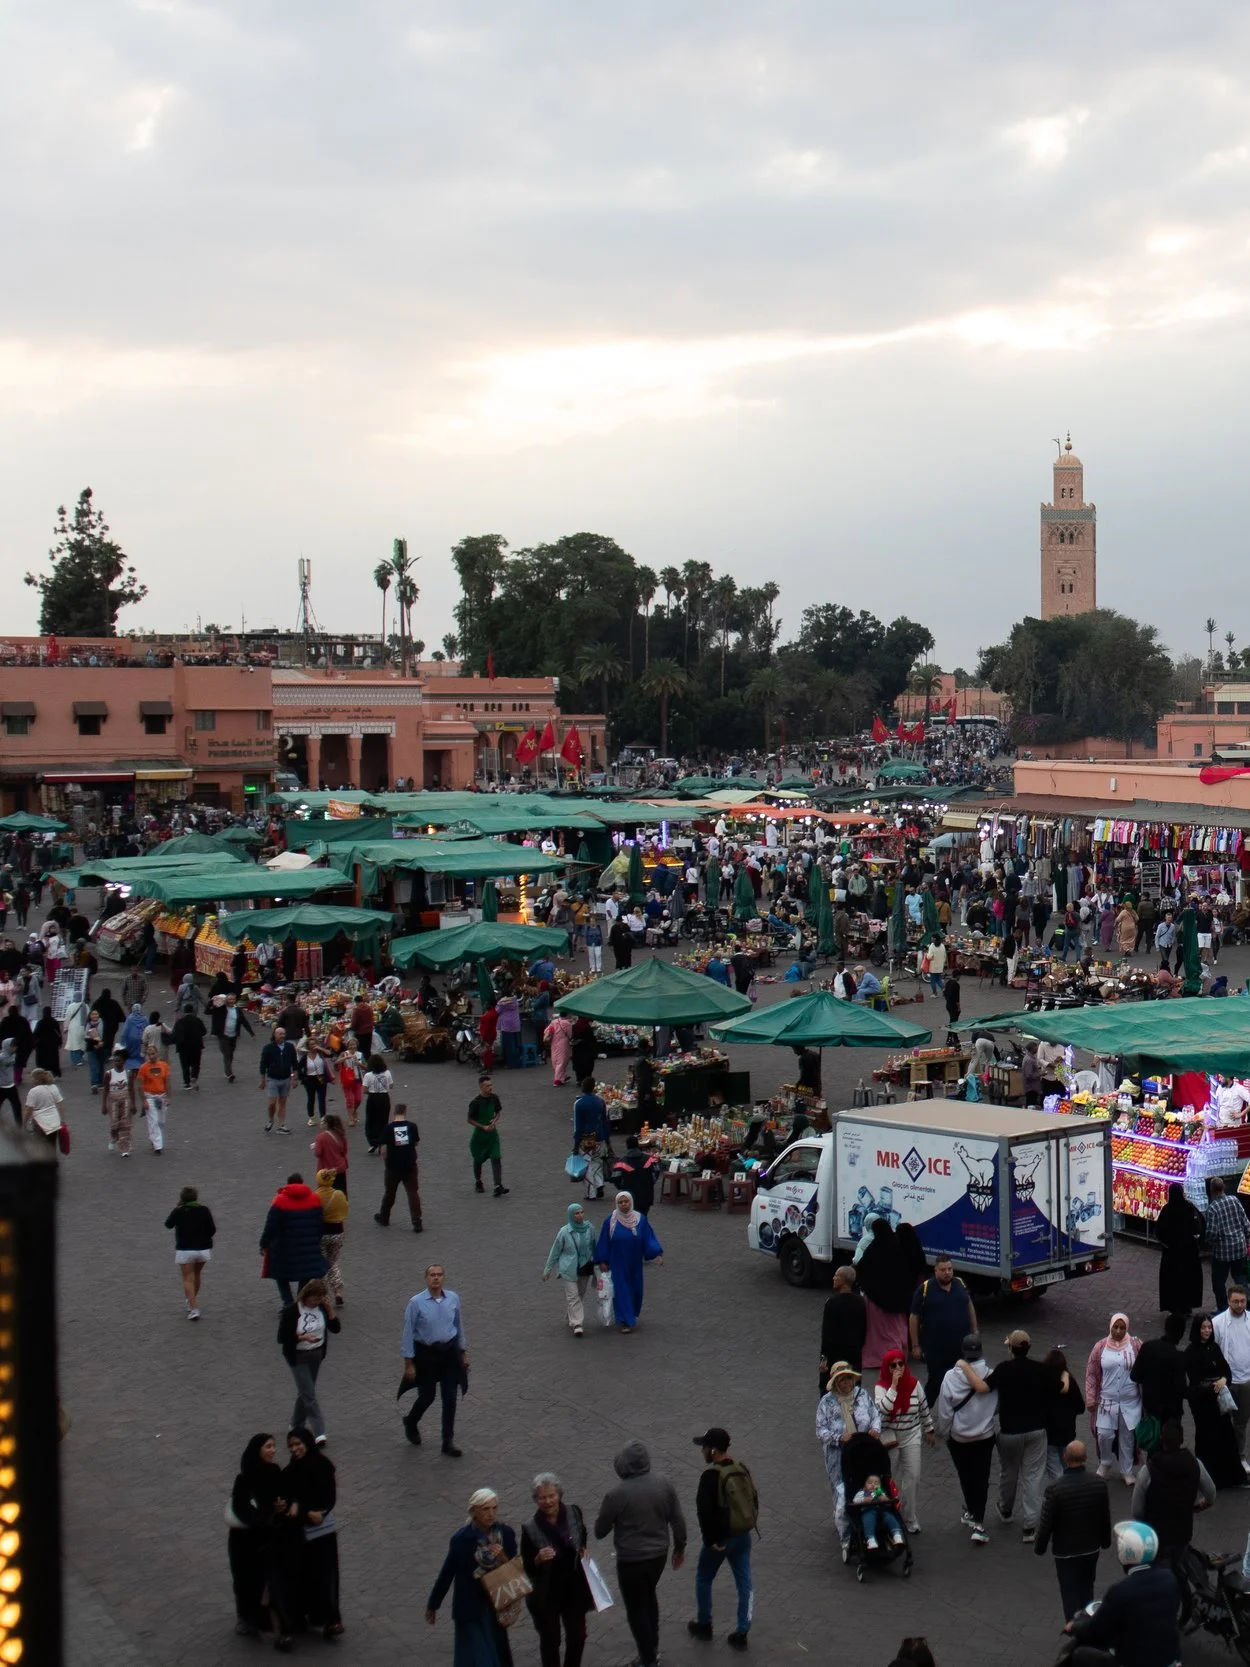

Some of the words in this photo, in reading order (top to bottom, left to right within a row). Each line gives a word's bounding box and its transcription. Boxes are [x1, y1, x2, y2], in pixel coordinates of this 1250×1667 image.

[1086, 1142, 1095, 1150] ICE
[876, 1150, 900, 1169] MR
[928, 1157, 951, 1176] ICE
